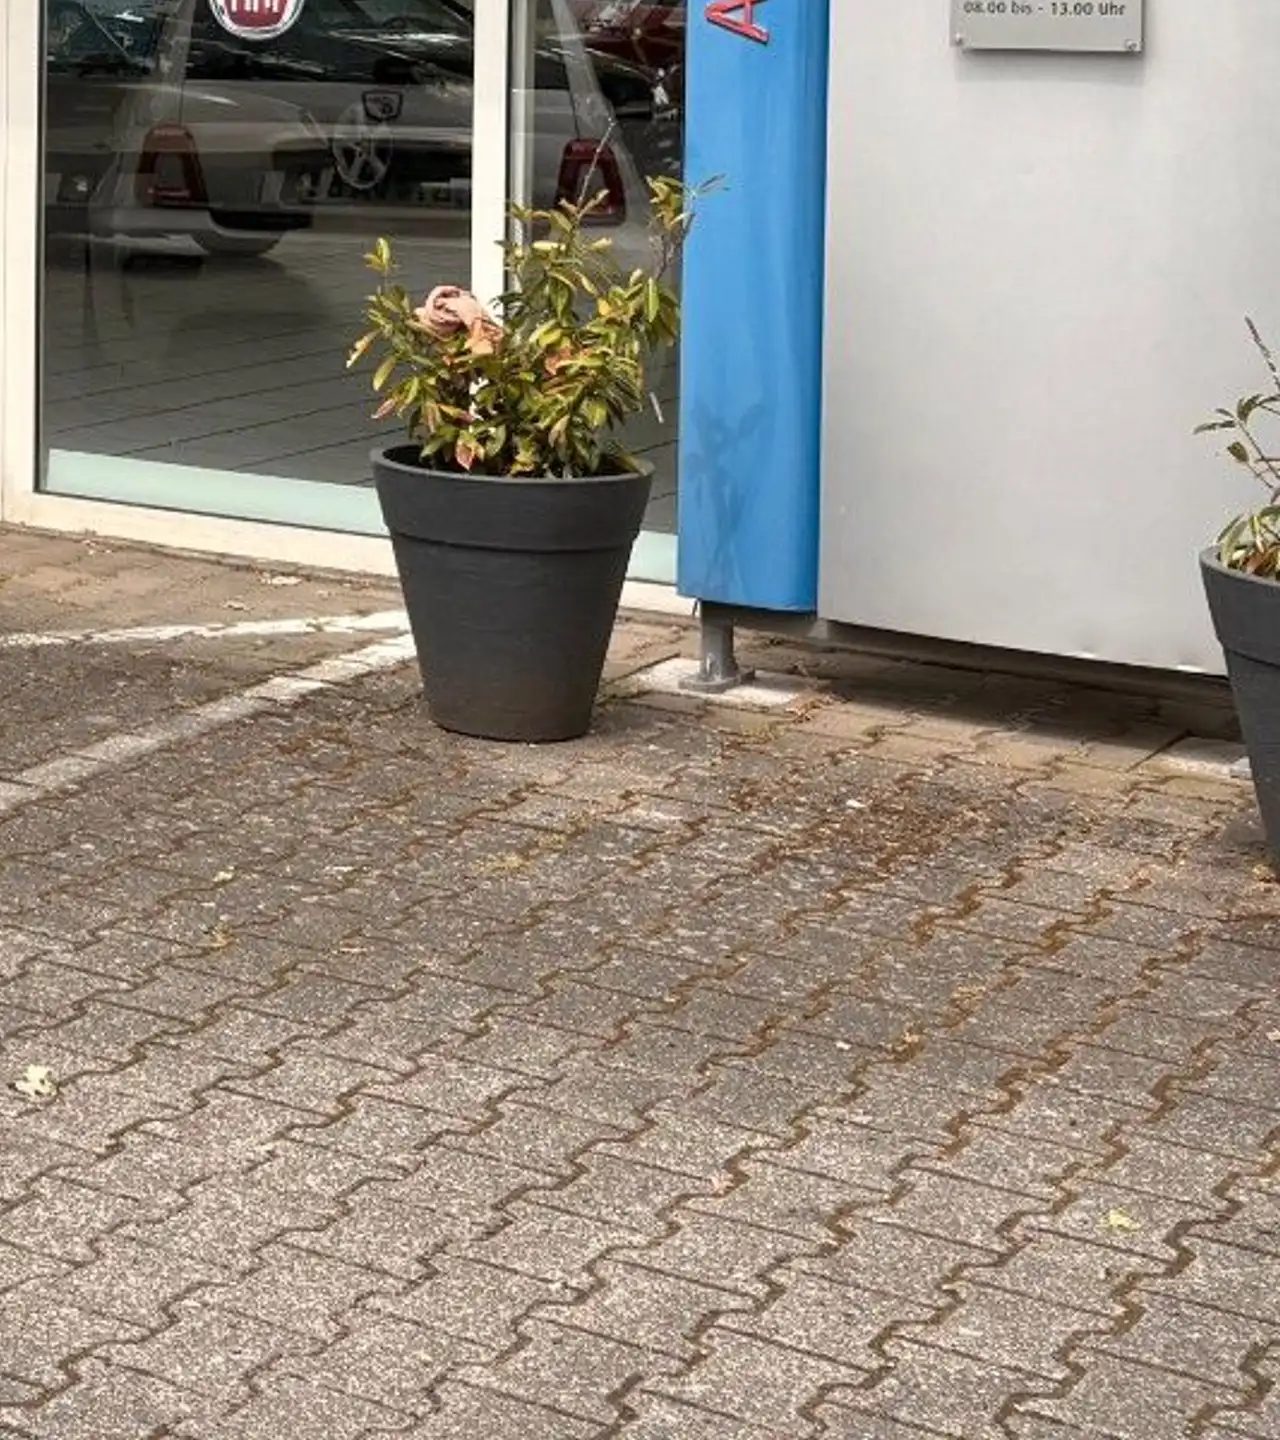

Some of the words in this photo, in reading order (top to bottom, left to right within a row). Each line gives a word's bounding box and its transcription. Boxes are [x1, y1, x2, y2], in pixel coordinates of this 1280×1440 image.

[964, 1, 1007, 15] 08.00
[1011, 1, 1032, 15] bis
[1051, 1, 1094, 16] 13.00
[1099, 1, 1127, 16] Uhr
